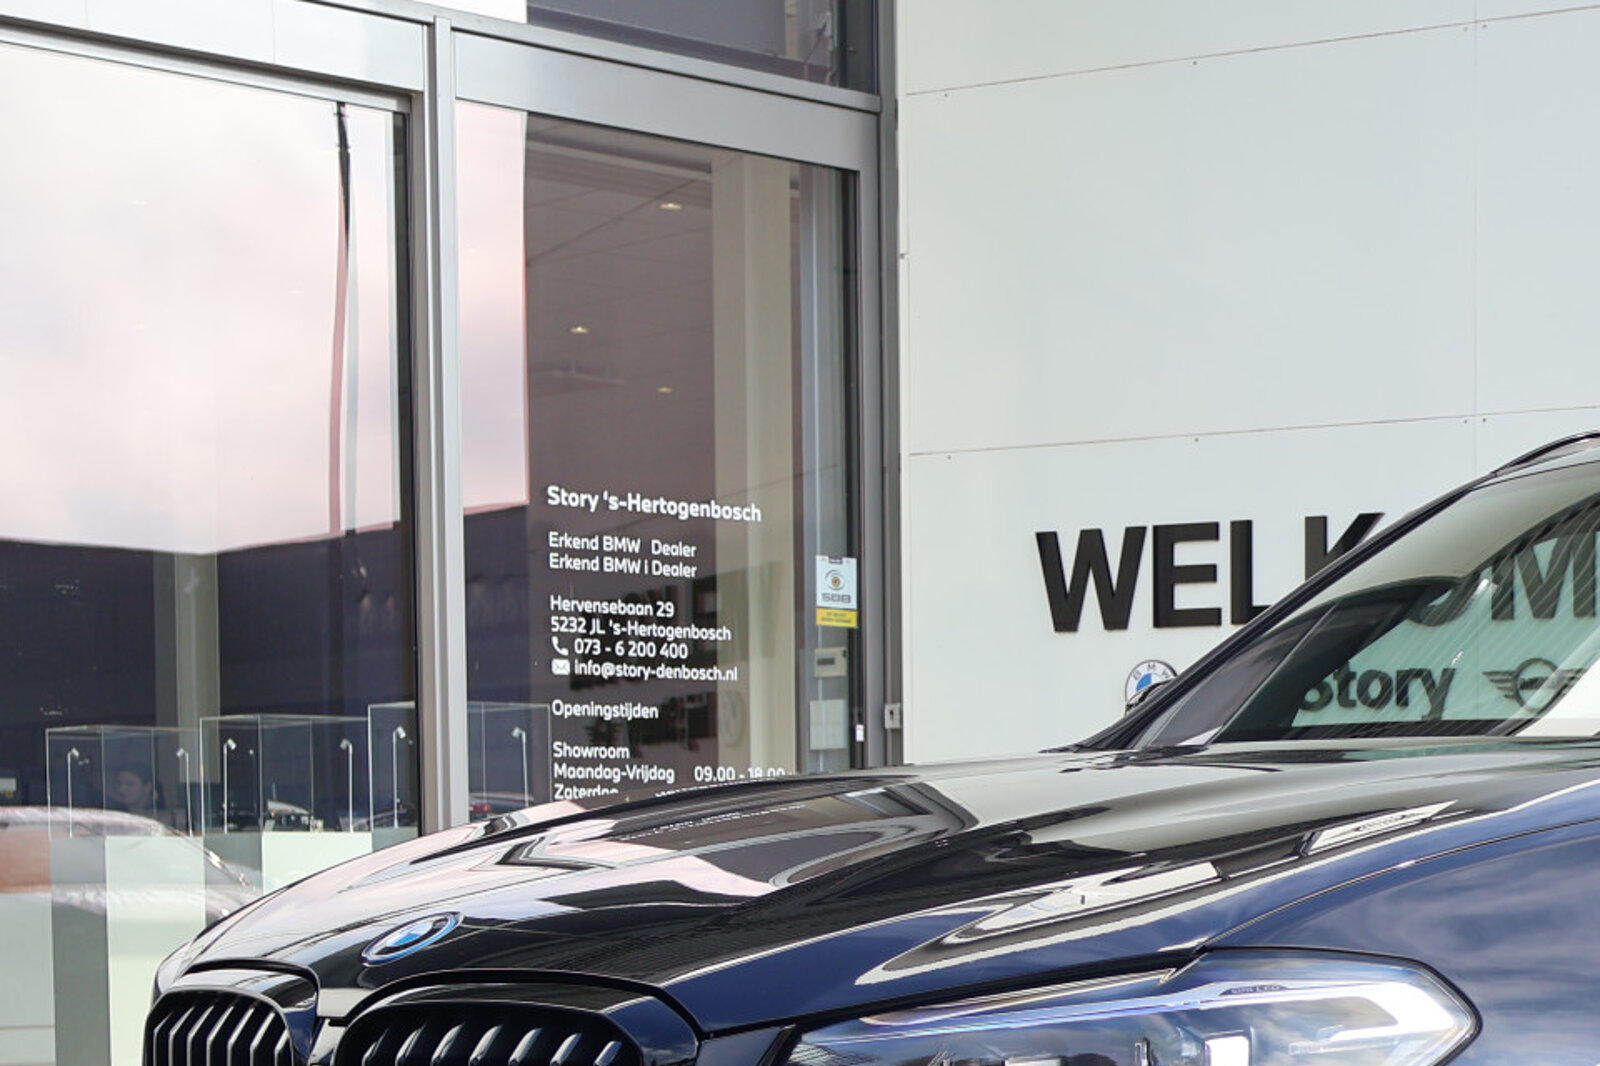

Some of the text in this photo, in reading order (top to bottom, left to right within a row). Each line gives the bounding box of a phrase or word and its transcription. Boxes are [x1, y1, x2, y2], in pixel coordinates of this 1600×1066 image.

[547, 485, 762, 522] Story 's-Hertogenbosch
[548, 531, 697, 557] Erkend BMW Dealer
[549, 552, 697, 578] Erkend BMW i Dealer
[550, 595, 675, 618] Hervensebaan 29
[551, 616, 732, 641] 5232 JL 's-Hertogenbosch
[574, 638, 601, 655] 073
[615, 641, 624, 656] 6
[628, 641, 657, 657] 200
[659, 643, 689, 659] 400
[574, 659, 738, 681] info@story-denbosch.nl
[552, 699, 659, 720] Openingstijden
[553, 742, 630, 759] Showroom
[554, 763, 675, 783] Maandag-Vrijdag
[694, 766, 736, 782] 09.00
[748, 767, 786, 778] 1800
